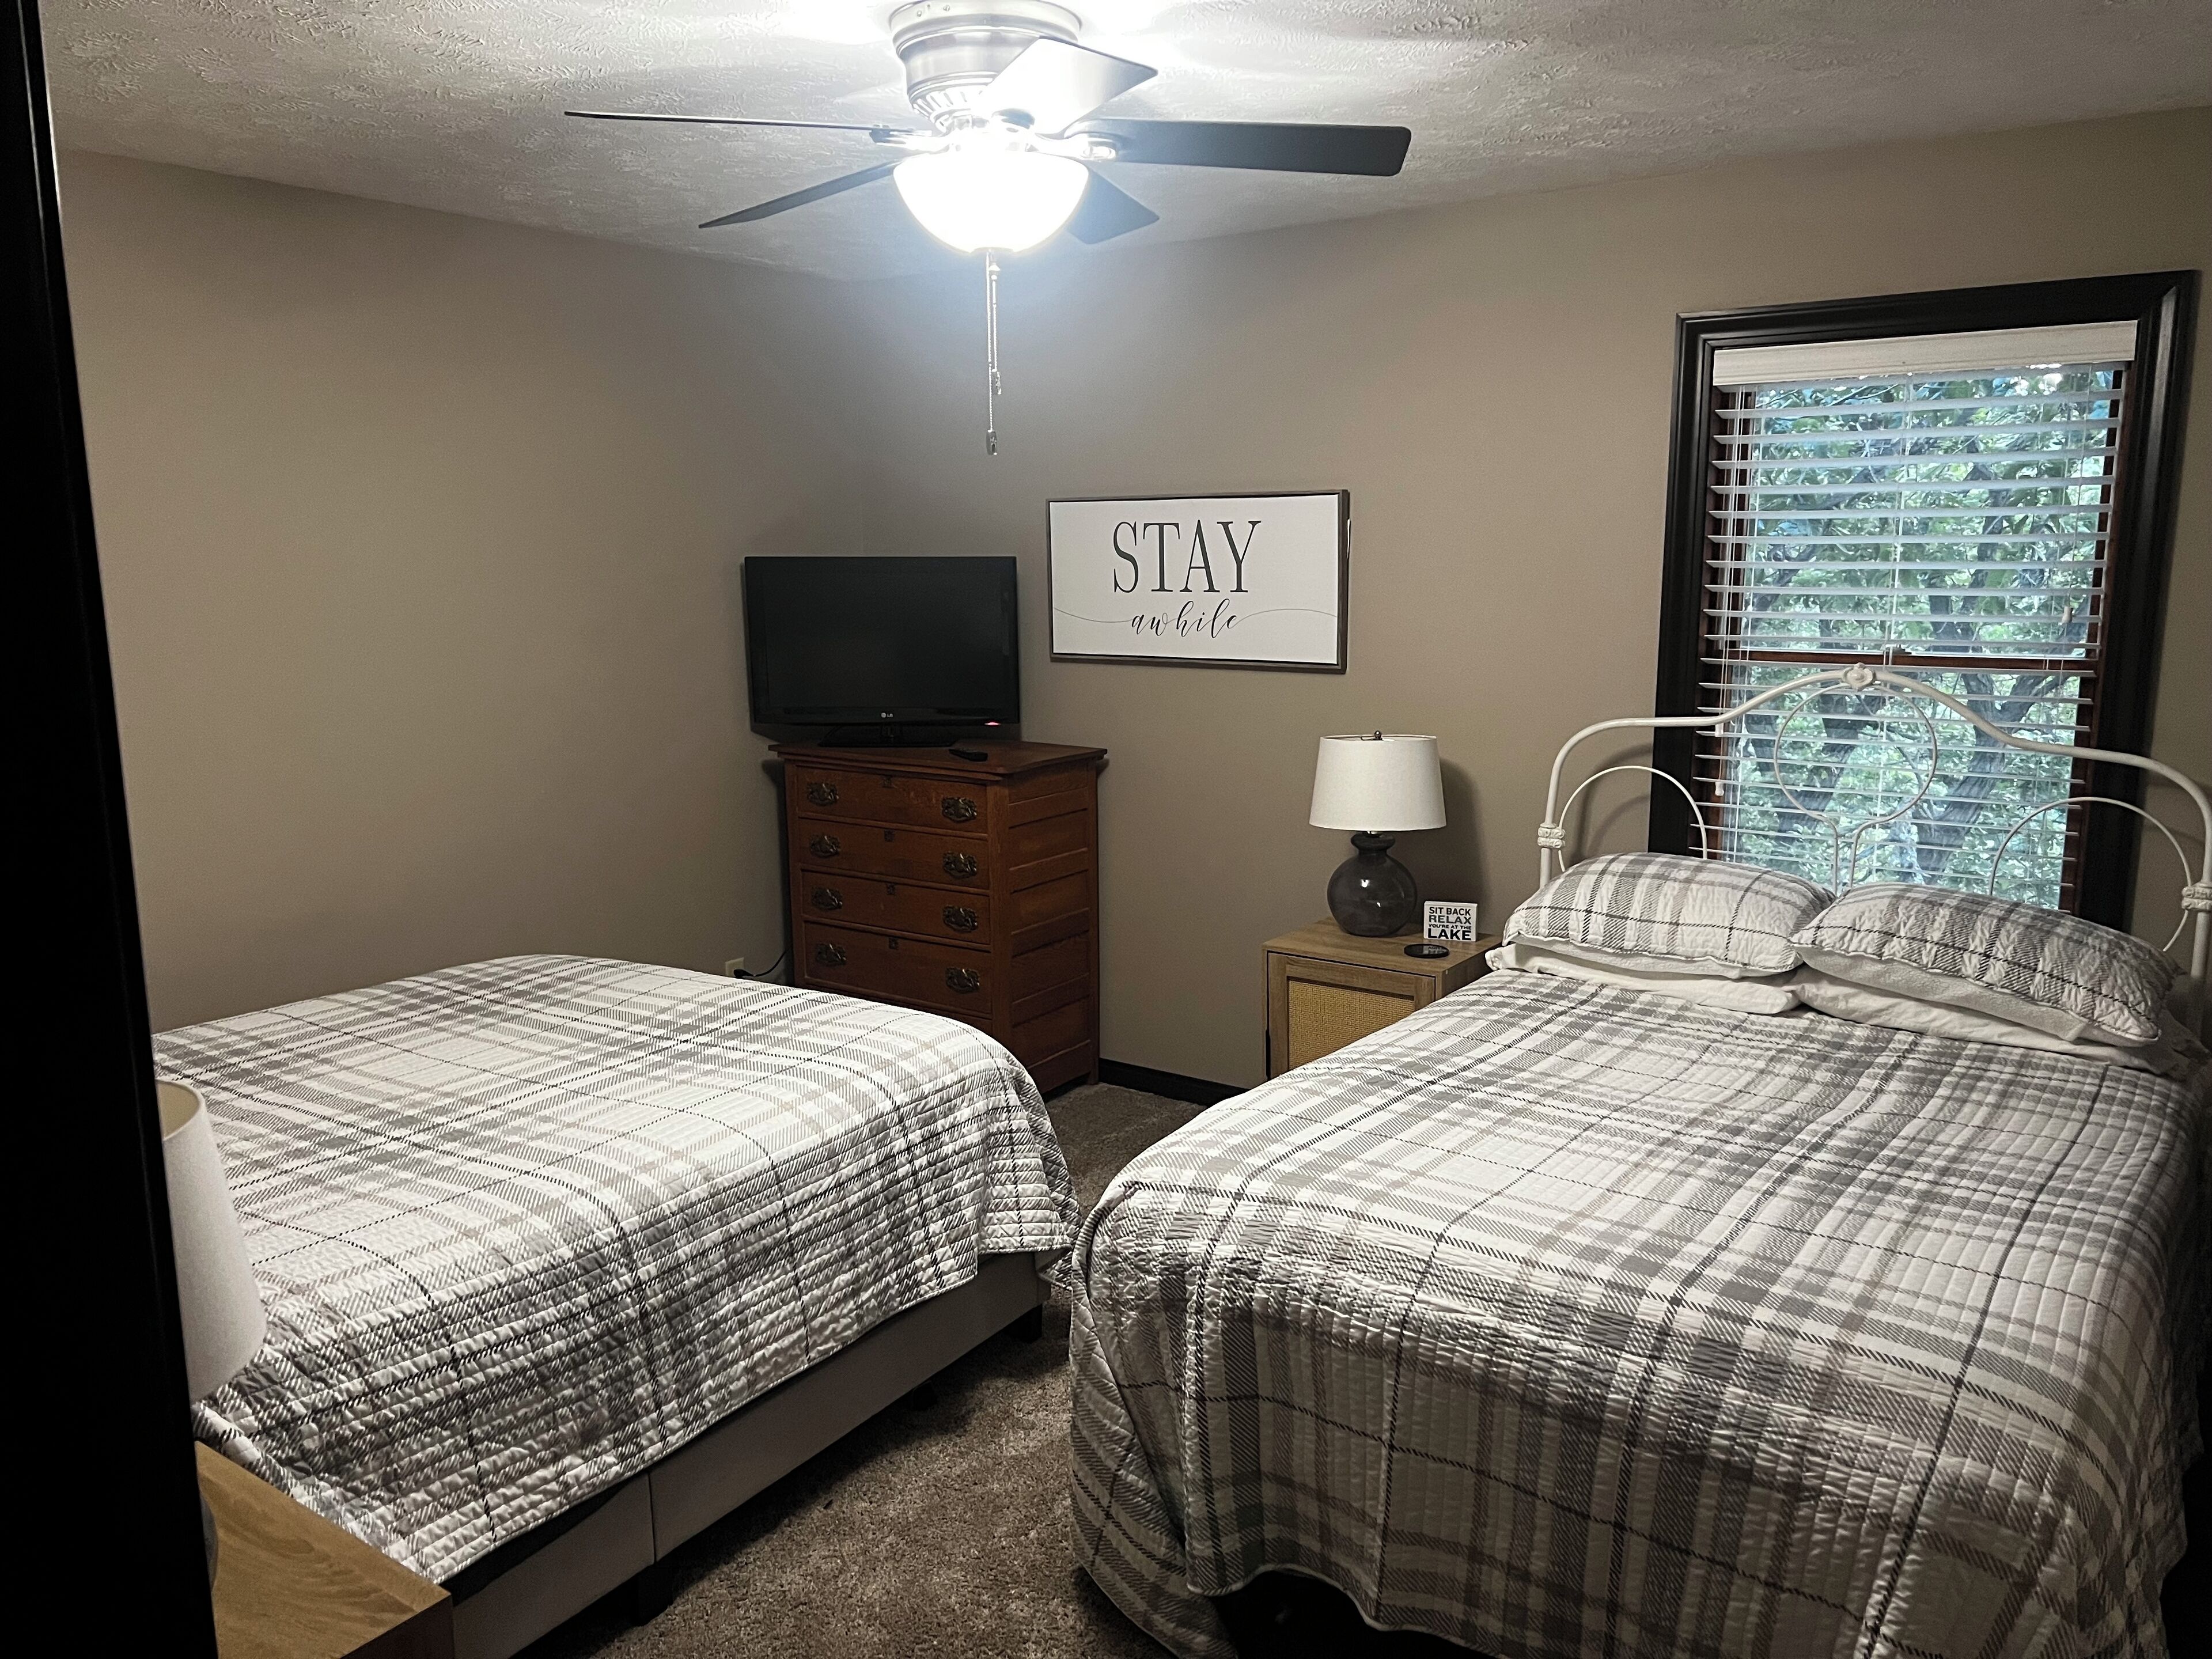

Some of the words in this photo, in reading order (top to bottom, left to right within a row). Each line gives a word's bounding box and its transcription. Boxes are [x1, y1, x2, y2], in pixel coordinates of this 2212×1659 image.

[1113, 520, 1262, 593] STAY
[1131, 599, 1239, 638] awhile
[1446, 908, 1471, 916] BACK
[1429, 915, 1471, 925] RELAX
[1428, 928, 1471, 940] LAKE
